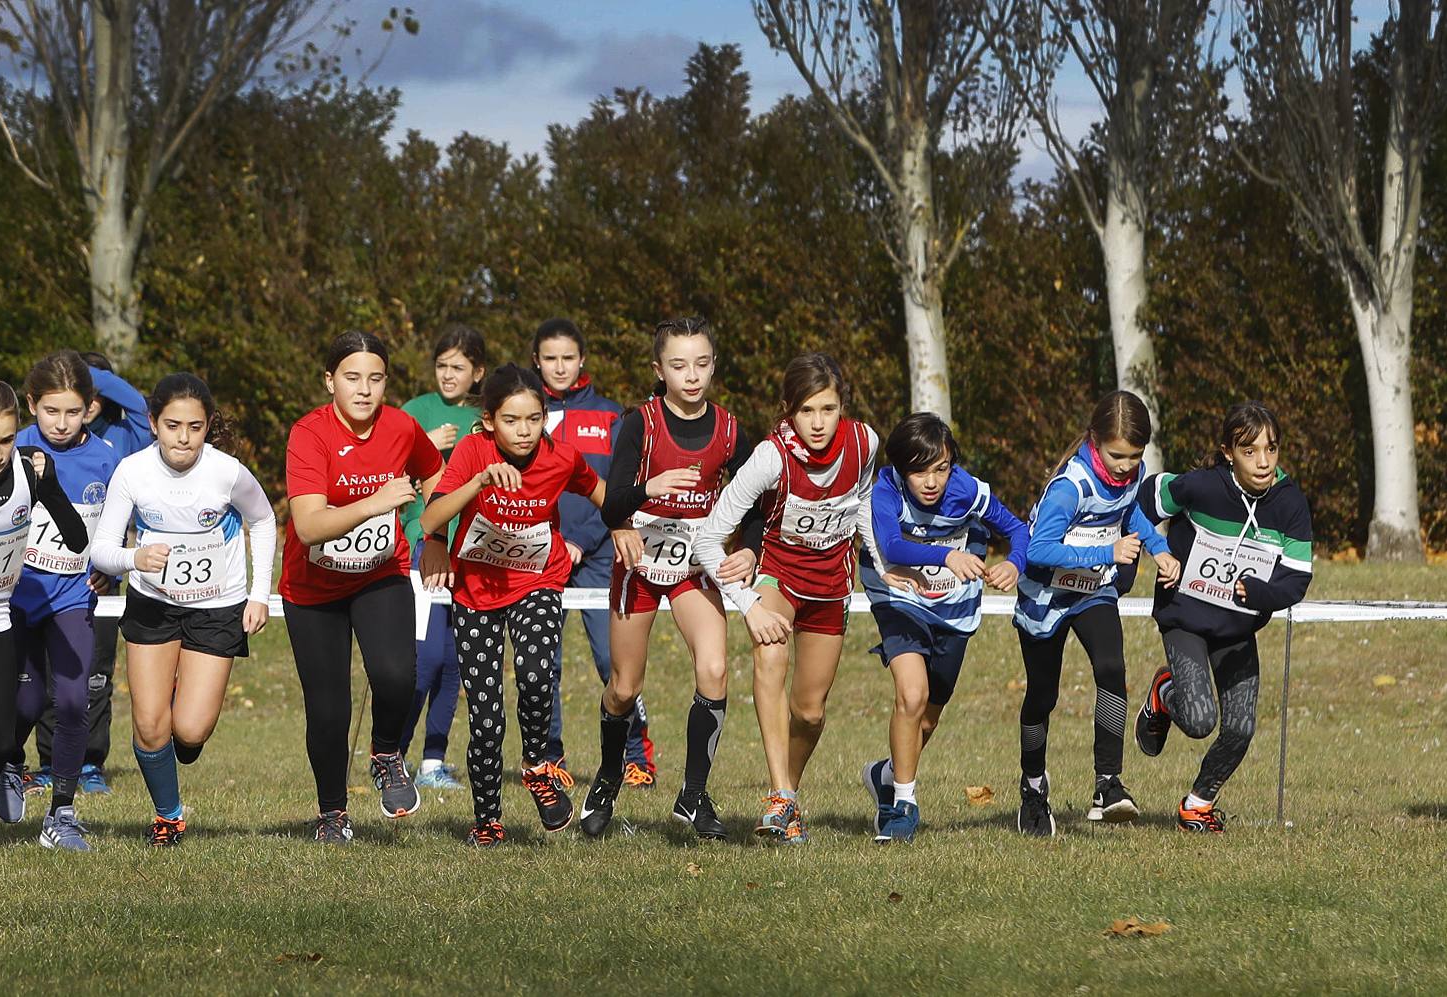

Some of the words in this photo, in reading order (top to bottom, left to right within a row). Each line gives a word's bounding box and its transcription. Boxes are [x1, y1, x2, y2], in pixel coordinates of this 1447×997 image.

[336, 471, 395, 486] AÑARES
[485, 492, 547, 508] AÑARES
[497, 507, 534, 517] RIOJA
[494, 522, 531, 532] ALUD
[634, 518, 663, 532] Gobierno
[795, 507, 848, 534] 911
[36, 521, 65, 550] 14
[319, 524, 391, 553] 568
[474, 530, 548, 560] 1567
[1196, 539, 1224, 553] Gobierno
[38, 556, 84, 570] ATLETISMO
[1206, 586, 1234, 602] ATLET
